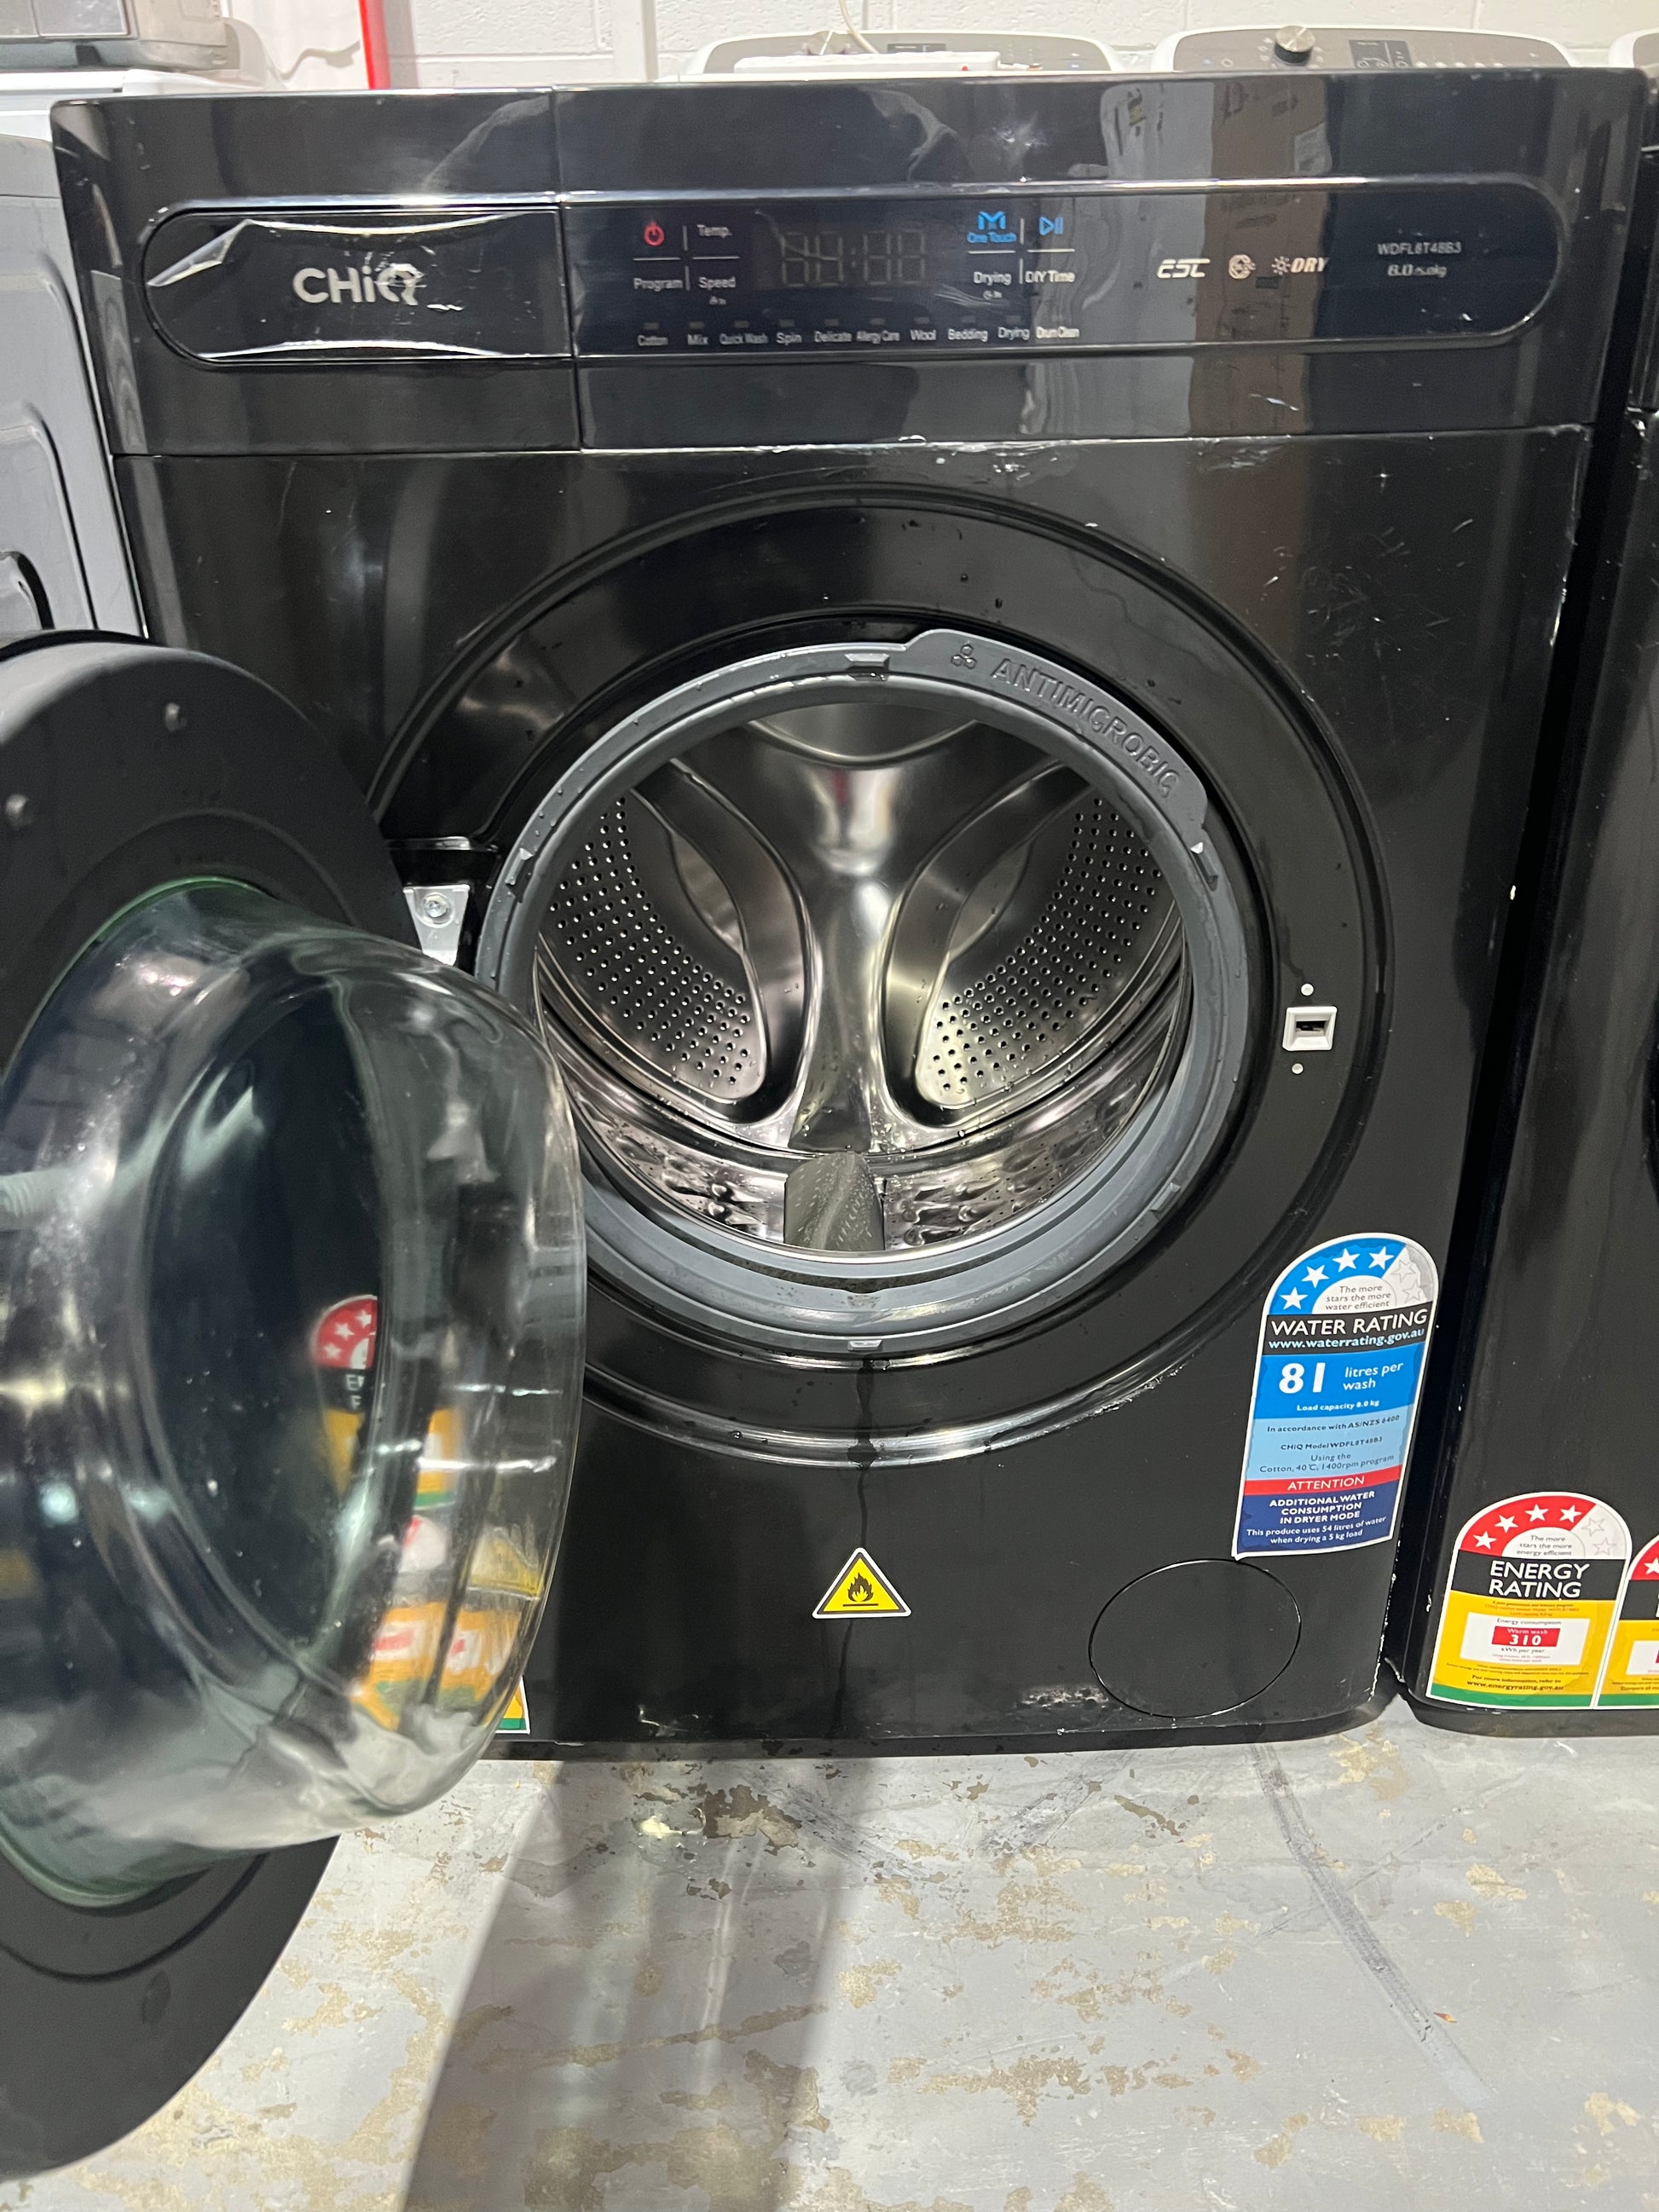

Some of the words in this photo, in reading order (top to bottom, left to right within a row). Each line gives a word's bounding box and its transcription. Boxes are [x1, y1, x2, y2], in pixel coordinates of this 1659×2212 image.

[1290, 257, 1329, 273] DRY
[698, 275, 736, 291] Speed
[974, 270, 1012, 286] Drying
[1025, 270, 1046, 283] DIY
[1048, 269, 1076, 283] Time
[633, 277, 683, 292] Program
[687, 333, 708, 345] Mix
[777, 332, 802, 345] Spin
[910, 329, 937, 341] Wool
[947, 328, 988, 342] Bedding
[997, 326, 1030, 340] Drying
[1354, 1301, 1390, 1309] efficient
[1271, 1320, 1346, 1336] WATER
[1352, 1308, 1428, 1334] RATING
[1268, 1328, 1425, 1349] www.waterrating.gov.au
[1344, 1366, 1379, 1378] litres
[1381, 1362, 1404, 1377] per
[1343, 1377, 1376, 1391] wash
[1320, 1402, 1355, 1412] capacity
[1348, 1418, 1380, 1429] AS/NZS
[1305, 1441, 1329, 1450] Model
[1259, 1464, 1295, 1473] Cotton,
[1321, 1461, 1359, 1470] 1400rpm
[1360, 1454, 1394, 1467] program
[1286, 1476, 1365, 1491] ATTENTION
[1269, 1496, 1339, 1507] ADDITIONAL
[1339, 1490, 1375, 1501] WATER
[1280, 1501, 1362, 1516] CONSUMPTION
[1293, 1514, 1328, 1524] DRYER
[1330, 1510, 1361, 1522] MODE
[1265, 1527, 1301, 1537] produce
[1333, 1522, 1354, 1532] litres
[1356, 1520, 1364, 1528] of
[1365, 1516, 1387, 1526] water
[1294, 1533, 1321, 1545] drying
[1335, 1532, 1345, 1542] kg
[1346, 1528, 1363, 1538] load
[1489, 1560, 1590, 1580] ENERGY
[1488, 1580, 1582, 1598] RATING
[1509, 1634, 1542, 1646] 310
[1466, 1679, 1564, 1691] www.energyrating.gov.au
